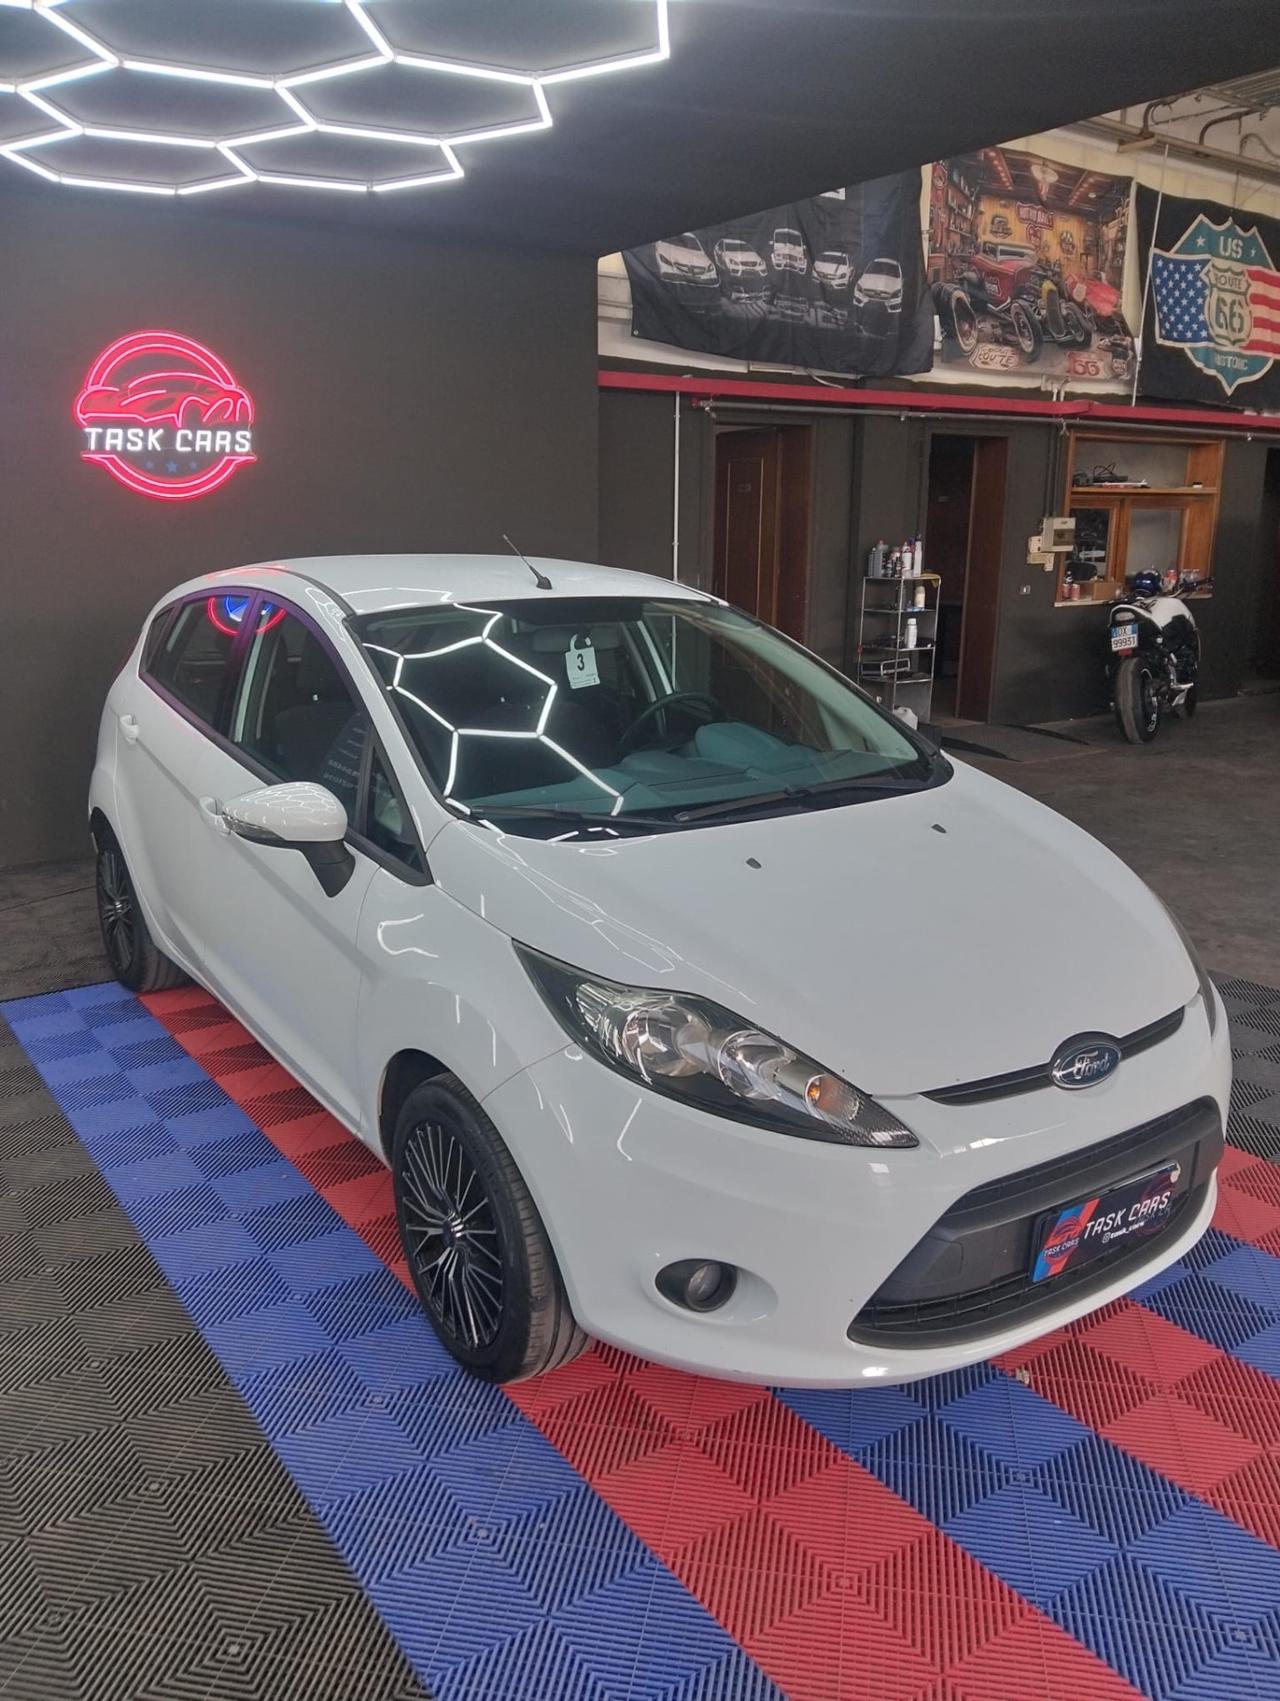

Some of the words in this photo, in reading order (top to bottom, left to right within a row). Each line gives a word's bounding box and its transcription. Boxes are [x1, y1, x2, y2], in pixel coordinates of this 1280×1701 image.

[1219, 236, 1244, 259] US
[1214, 297, 1245, 335] 66
[84, 428, 164, 451] TASK
[175, 429, 252, 452] CARS
[577, 653, 585, 671] 3
[1073, 1050, 1110, 1080] Ford
[1084, 1208, 1127, 1240] TASK
[1128, 1191, 1171, 1222] CARS
